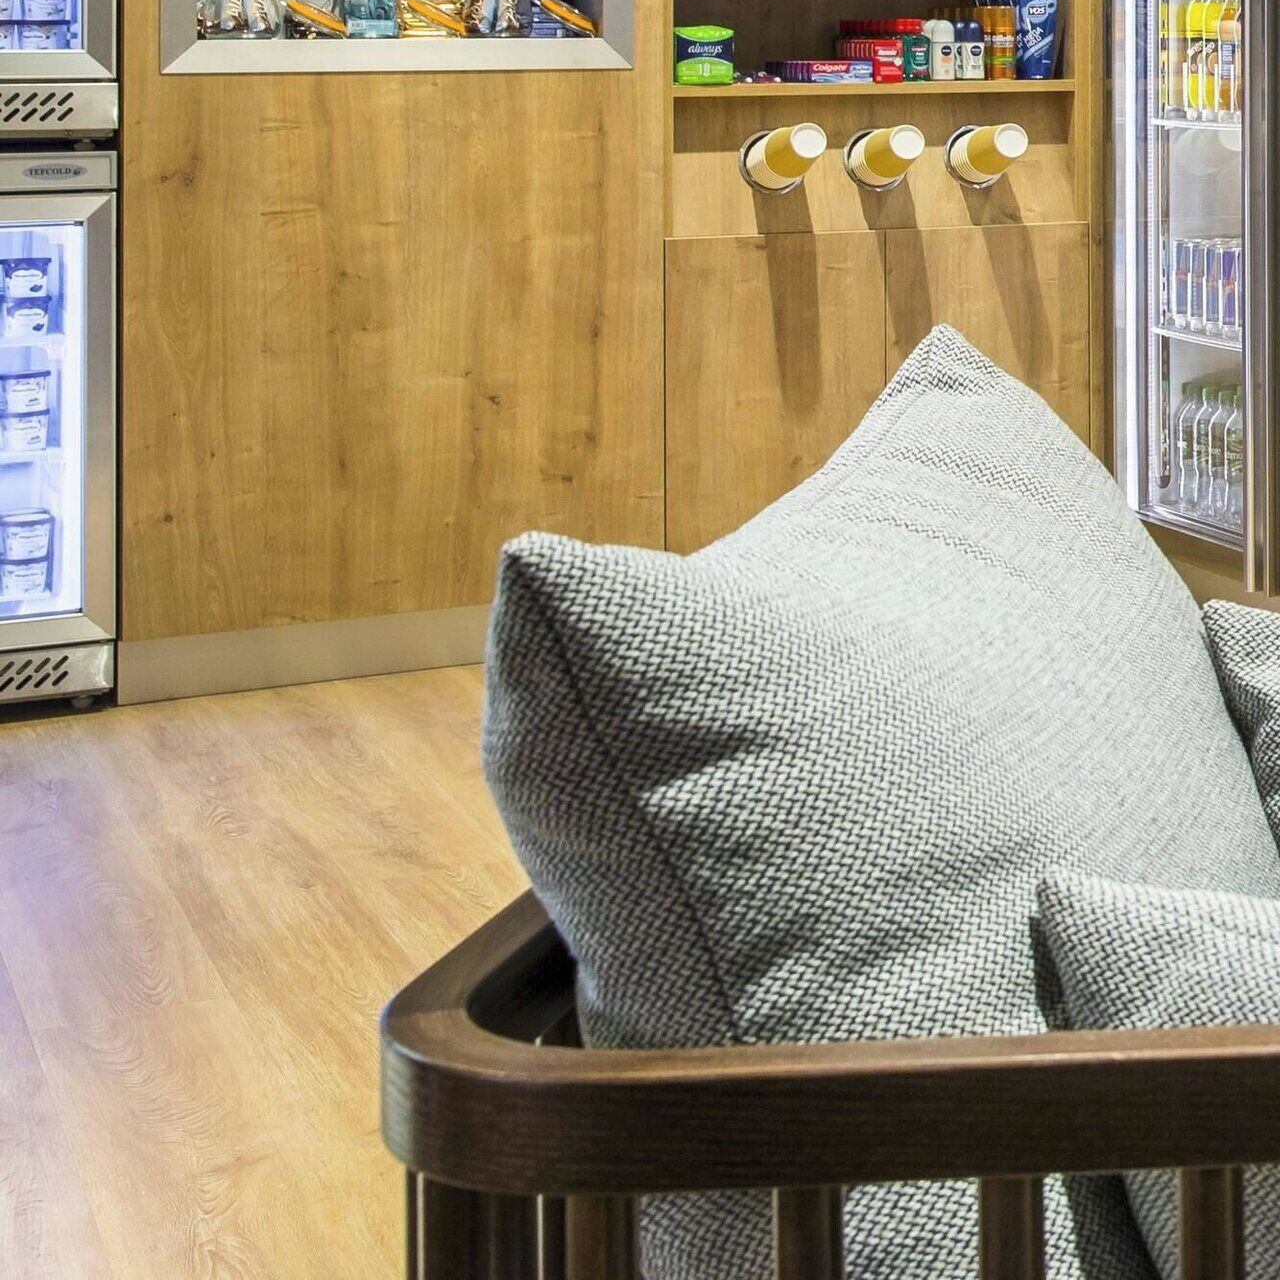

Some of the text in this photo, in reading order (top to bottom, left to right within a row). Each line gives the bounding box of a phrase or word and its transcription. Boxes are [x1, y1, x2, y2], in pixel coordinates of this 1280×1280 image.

[1023, 27, 1044, 43] MEGA
[688, 42, 723, 58] always
[812, 63, 848, 74] Colgate
[29, 167, 72, 176] TEFCOLD
